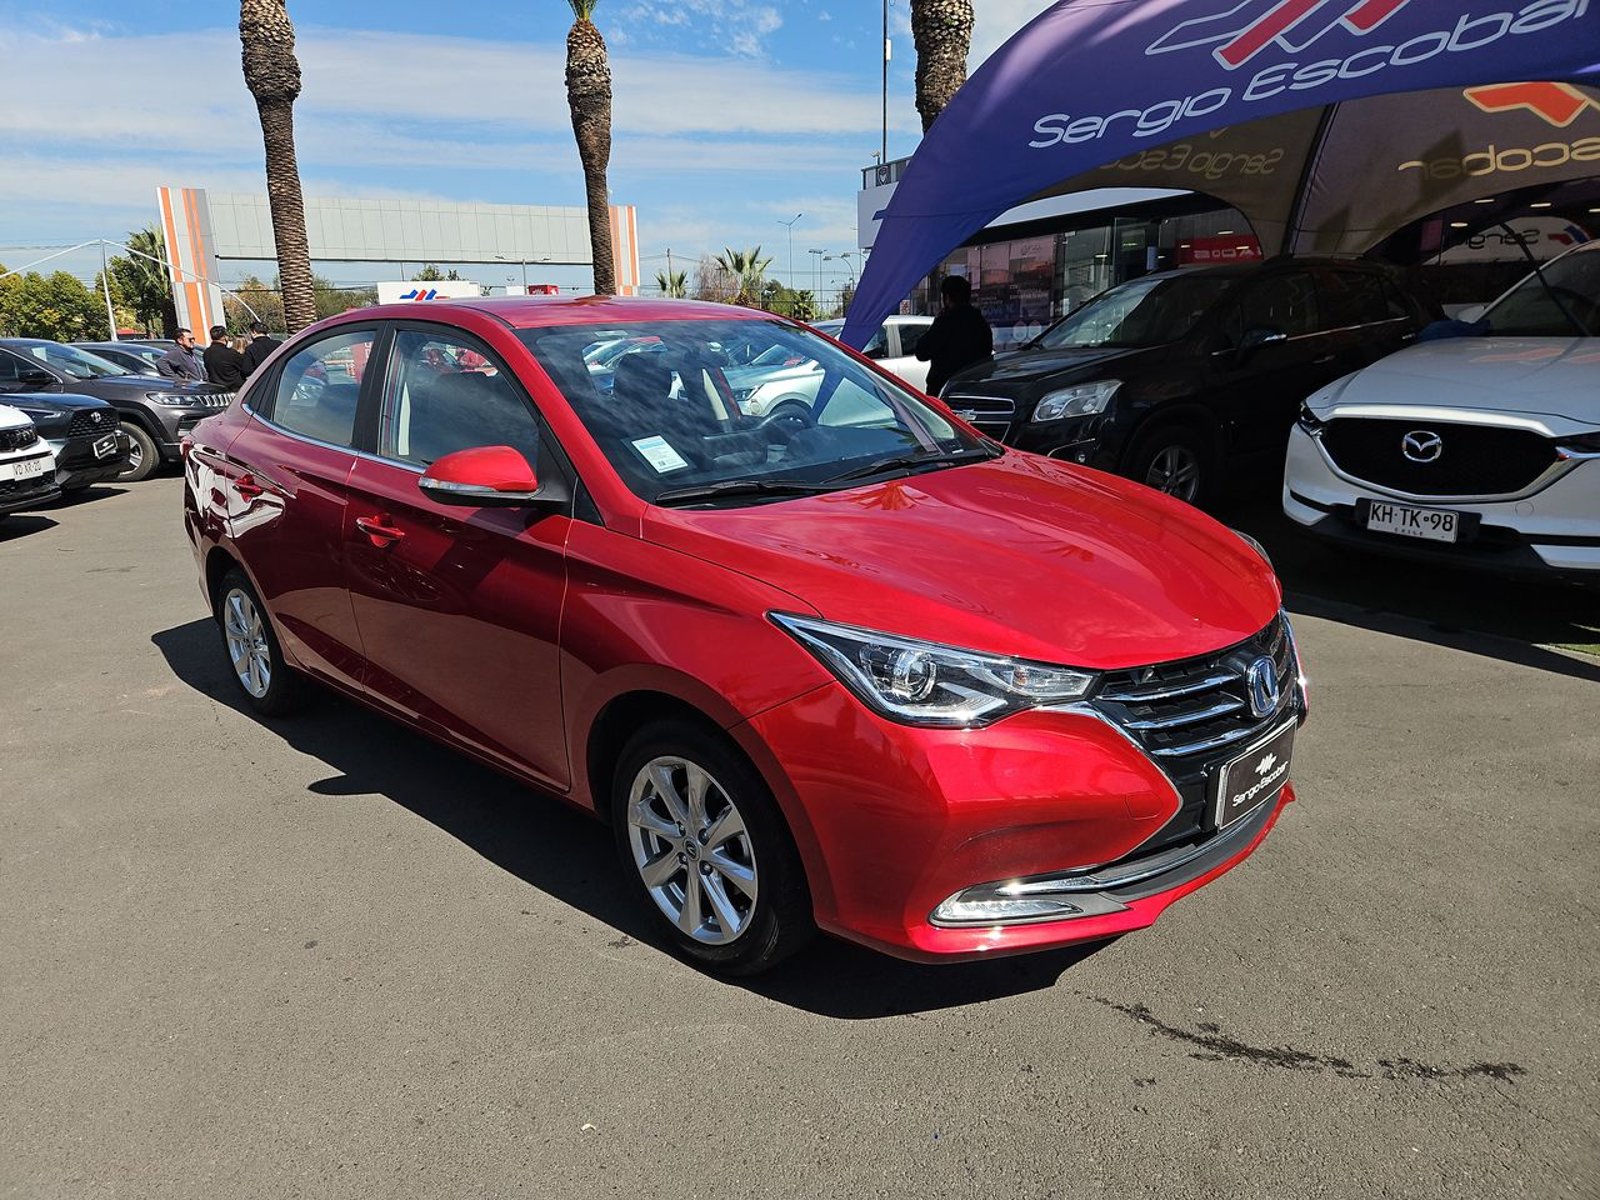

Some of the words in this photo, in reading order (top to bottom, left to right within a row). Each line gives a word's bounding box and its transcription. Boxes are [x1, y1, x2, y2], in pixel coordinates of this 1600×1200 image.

[1028, 86, 1231, 149] Sergio
[1242, 0, 1590, 102] Escobar
[1232, 783, 1260, 807] Sergio
